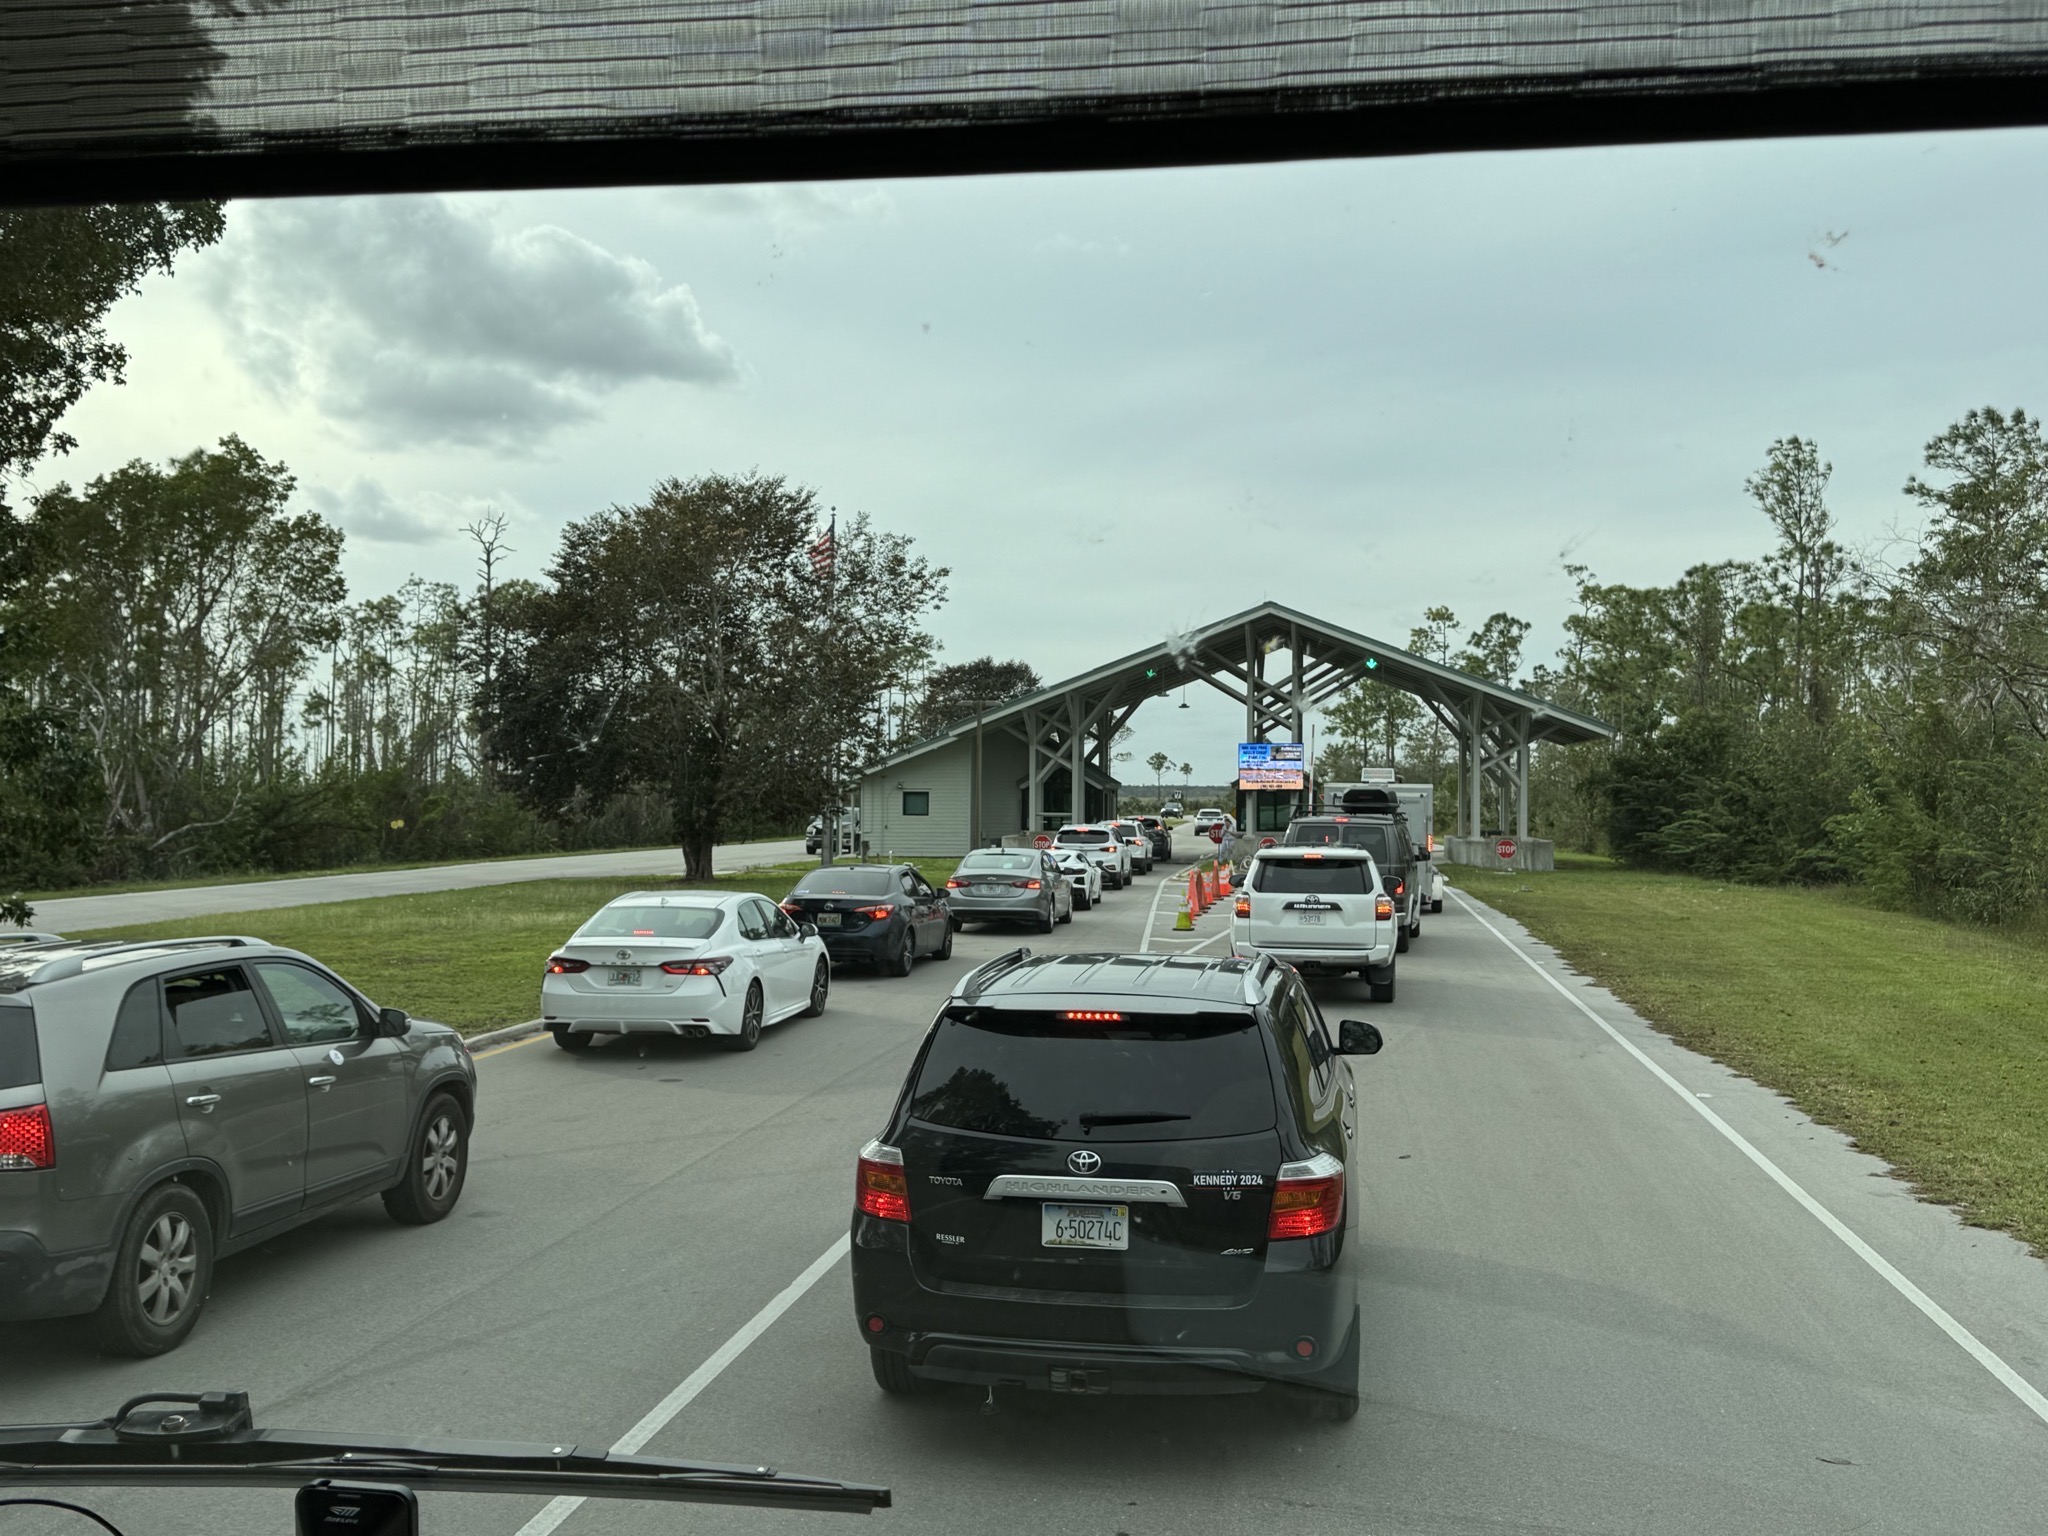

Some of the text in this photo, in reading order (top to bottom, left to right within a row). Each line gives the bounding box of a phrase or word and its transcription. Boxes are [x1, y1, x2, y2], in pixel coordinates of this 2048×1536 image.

[1033, 840, 1050, 849] STOP
[1496, 845, 1516, 854] STOP
[928, 1175, 963, 1186] TOYOTA
[1193, 1174, 1264, 1186] KENNEDY 2024
[1005, 1180, 1156, 1197] HIGHLANDER
[1223, 1190, 1242, 1201] V6
[935, 1233, 966, 1244] RESSLER
